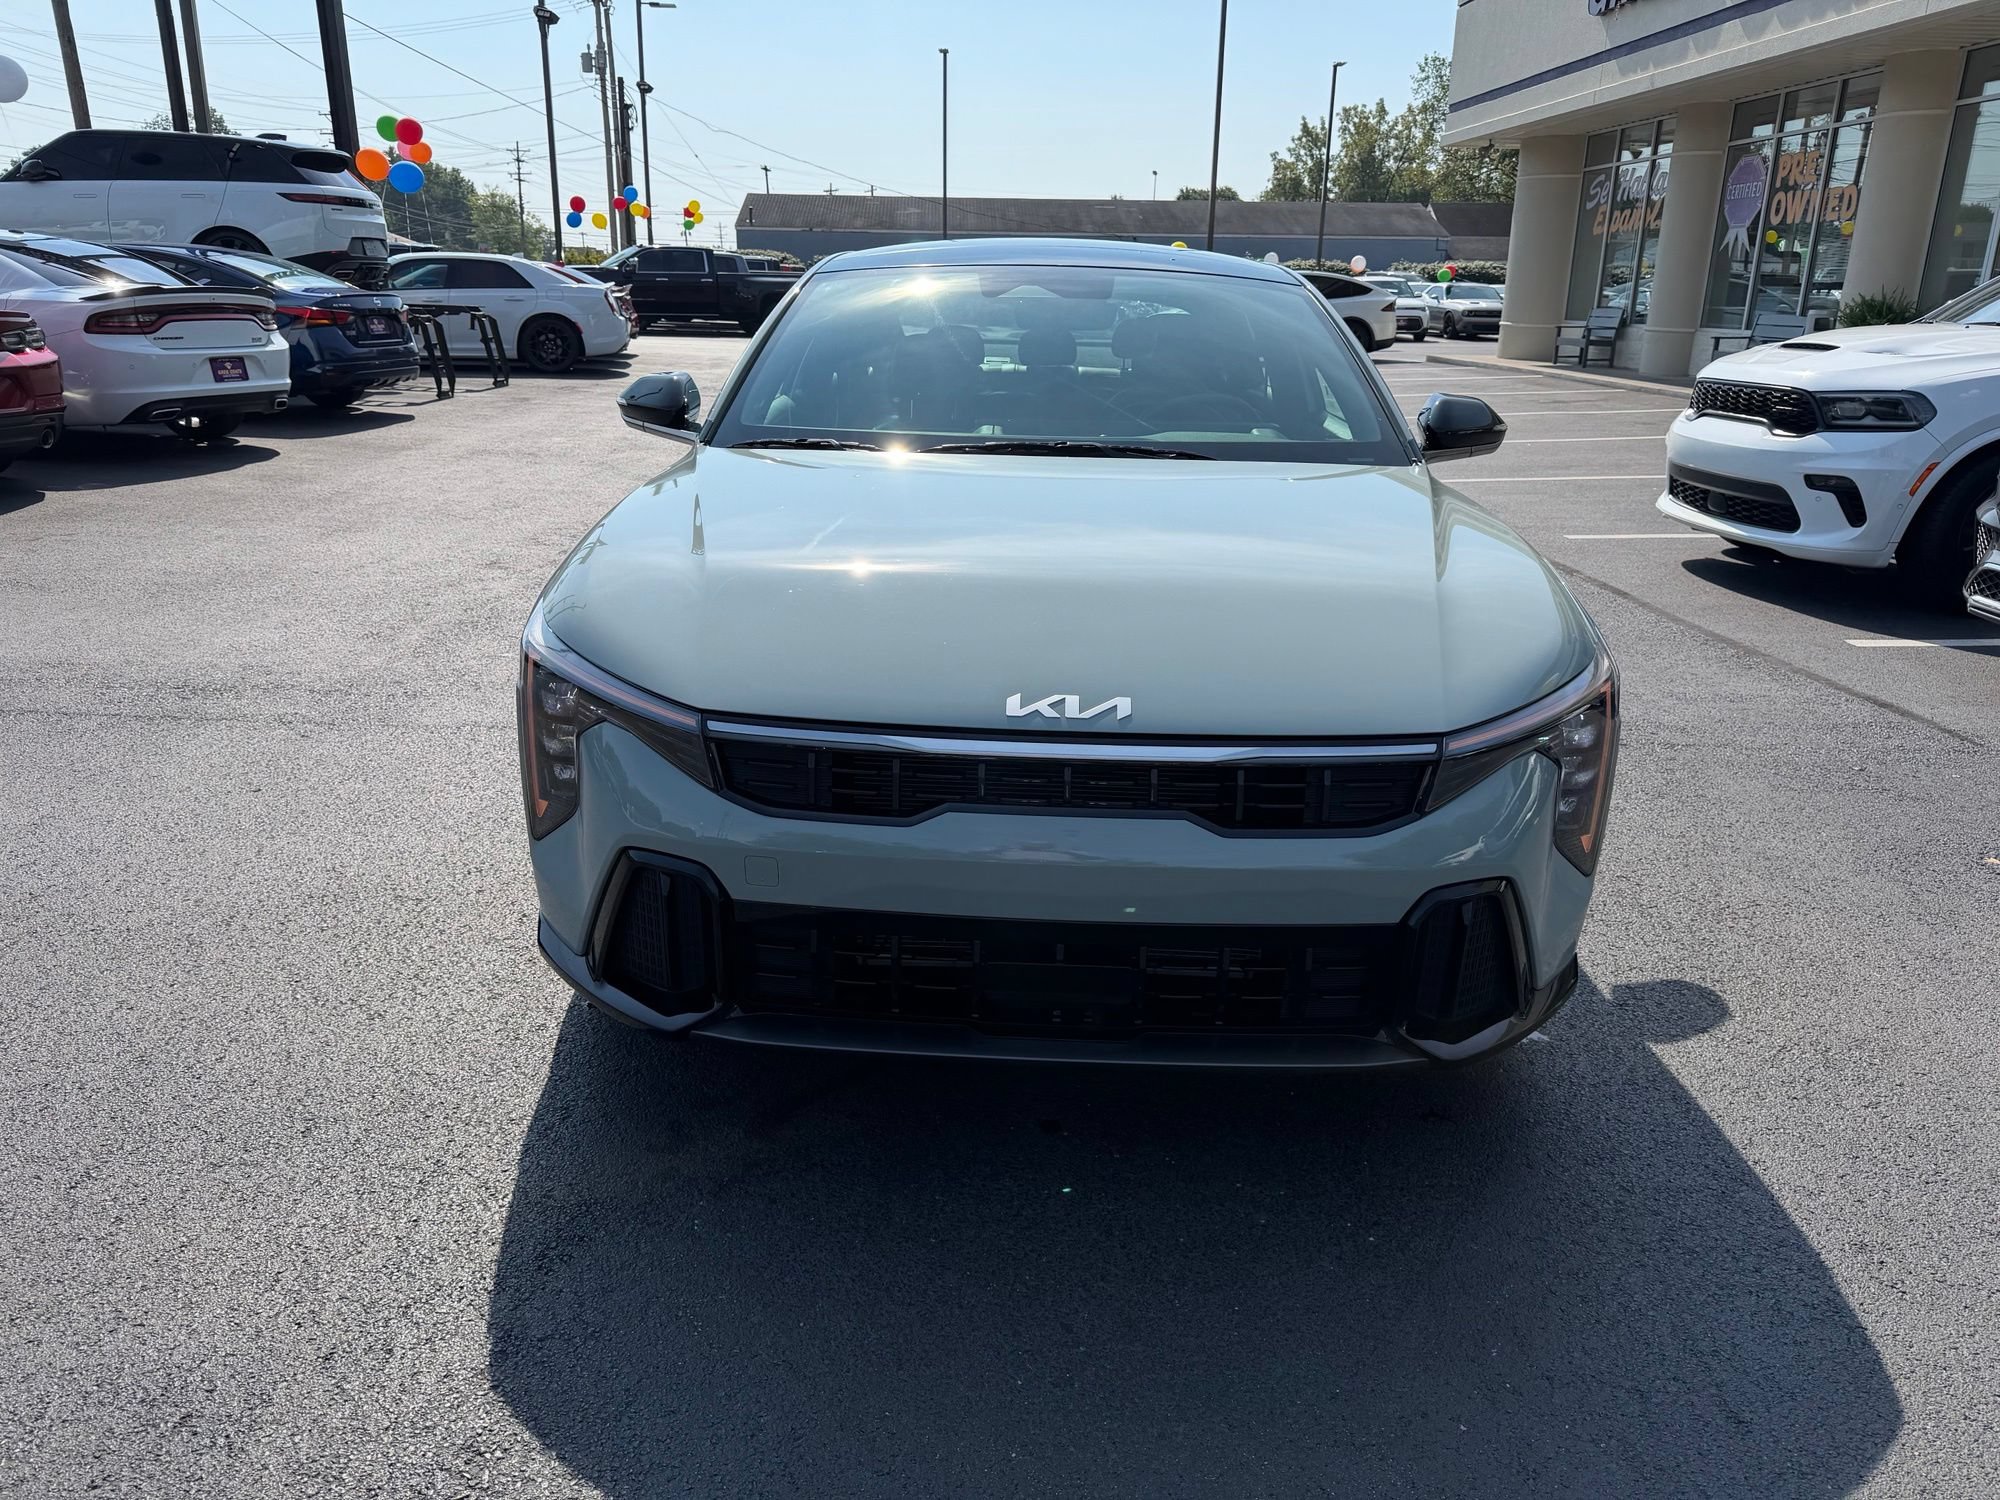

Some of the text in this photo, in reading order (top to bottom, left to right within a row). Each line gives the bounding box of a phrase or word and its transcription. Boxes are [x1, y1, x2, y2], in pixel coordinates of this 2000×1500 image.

[1585, 174, 1610, 210] Se
[1726, 182, 1763, 200] CERTIFIED
[1769, 183, 1858, 226] OWNED
[1593, 201, 1662, 237] Epañl
[1006, 692, 1132, 720] KIA
